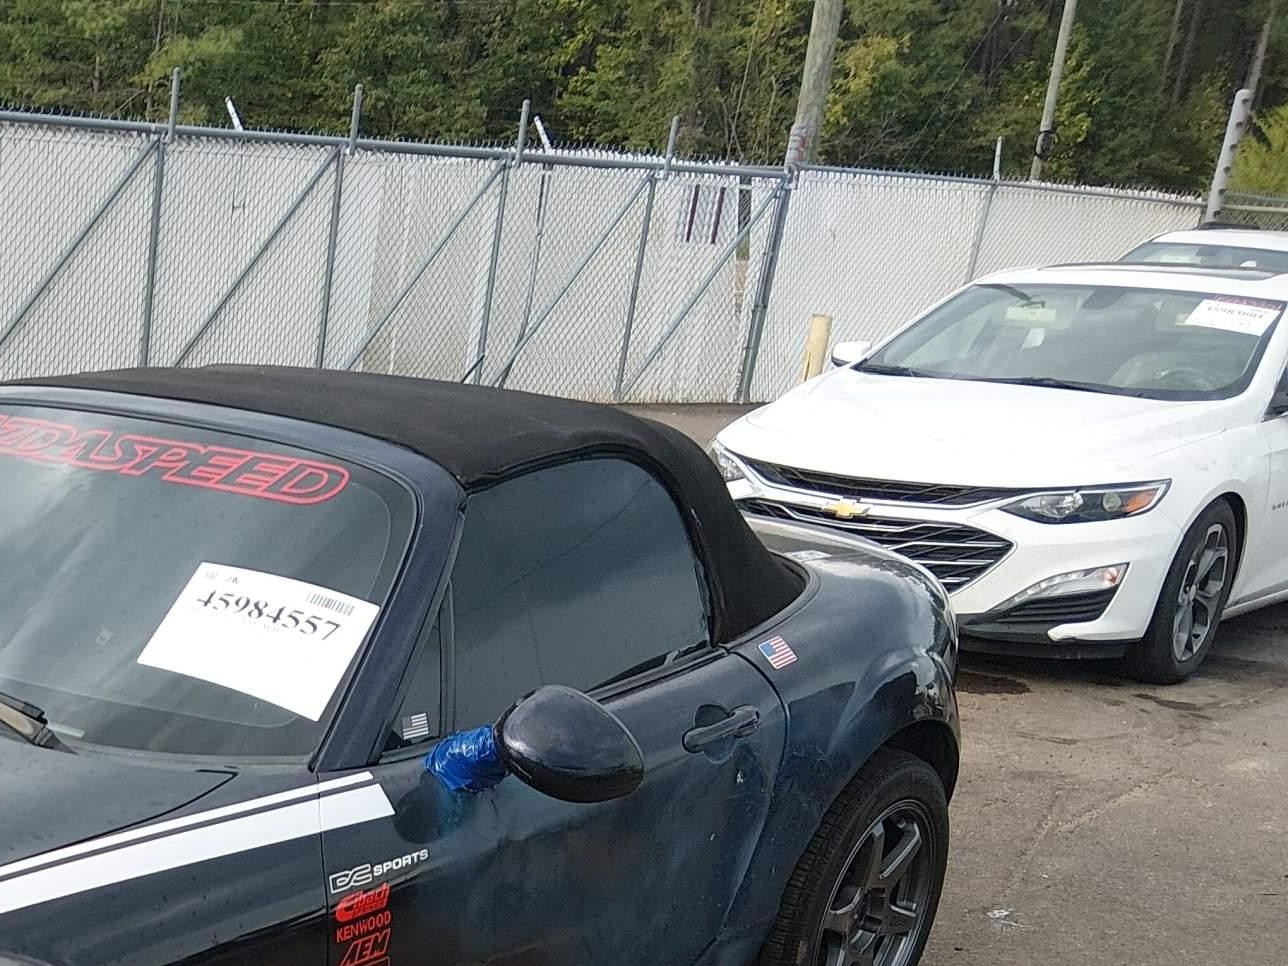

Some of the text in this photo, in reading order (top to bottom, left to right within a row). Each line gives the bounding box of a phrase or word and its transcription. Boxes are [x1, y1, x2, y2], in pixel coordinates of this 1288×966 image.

[196, 590, 342, 641] 45984557
[373, 849, 429, 877] SPORTS
[336, 911, 392, 943] KENWOOD
